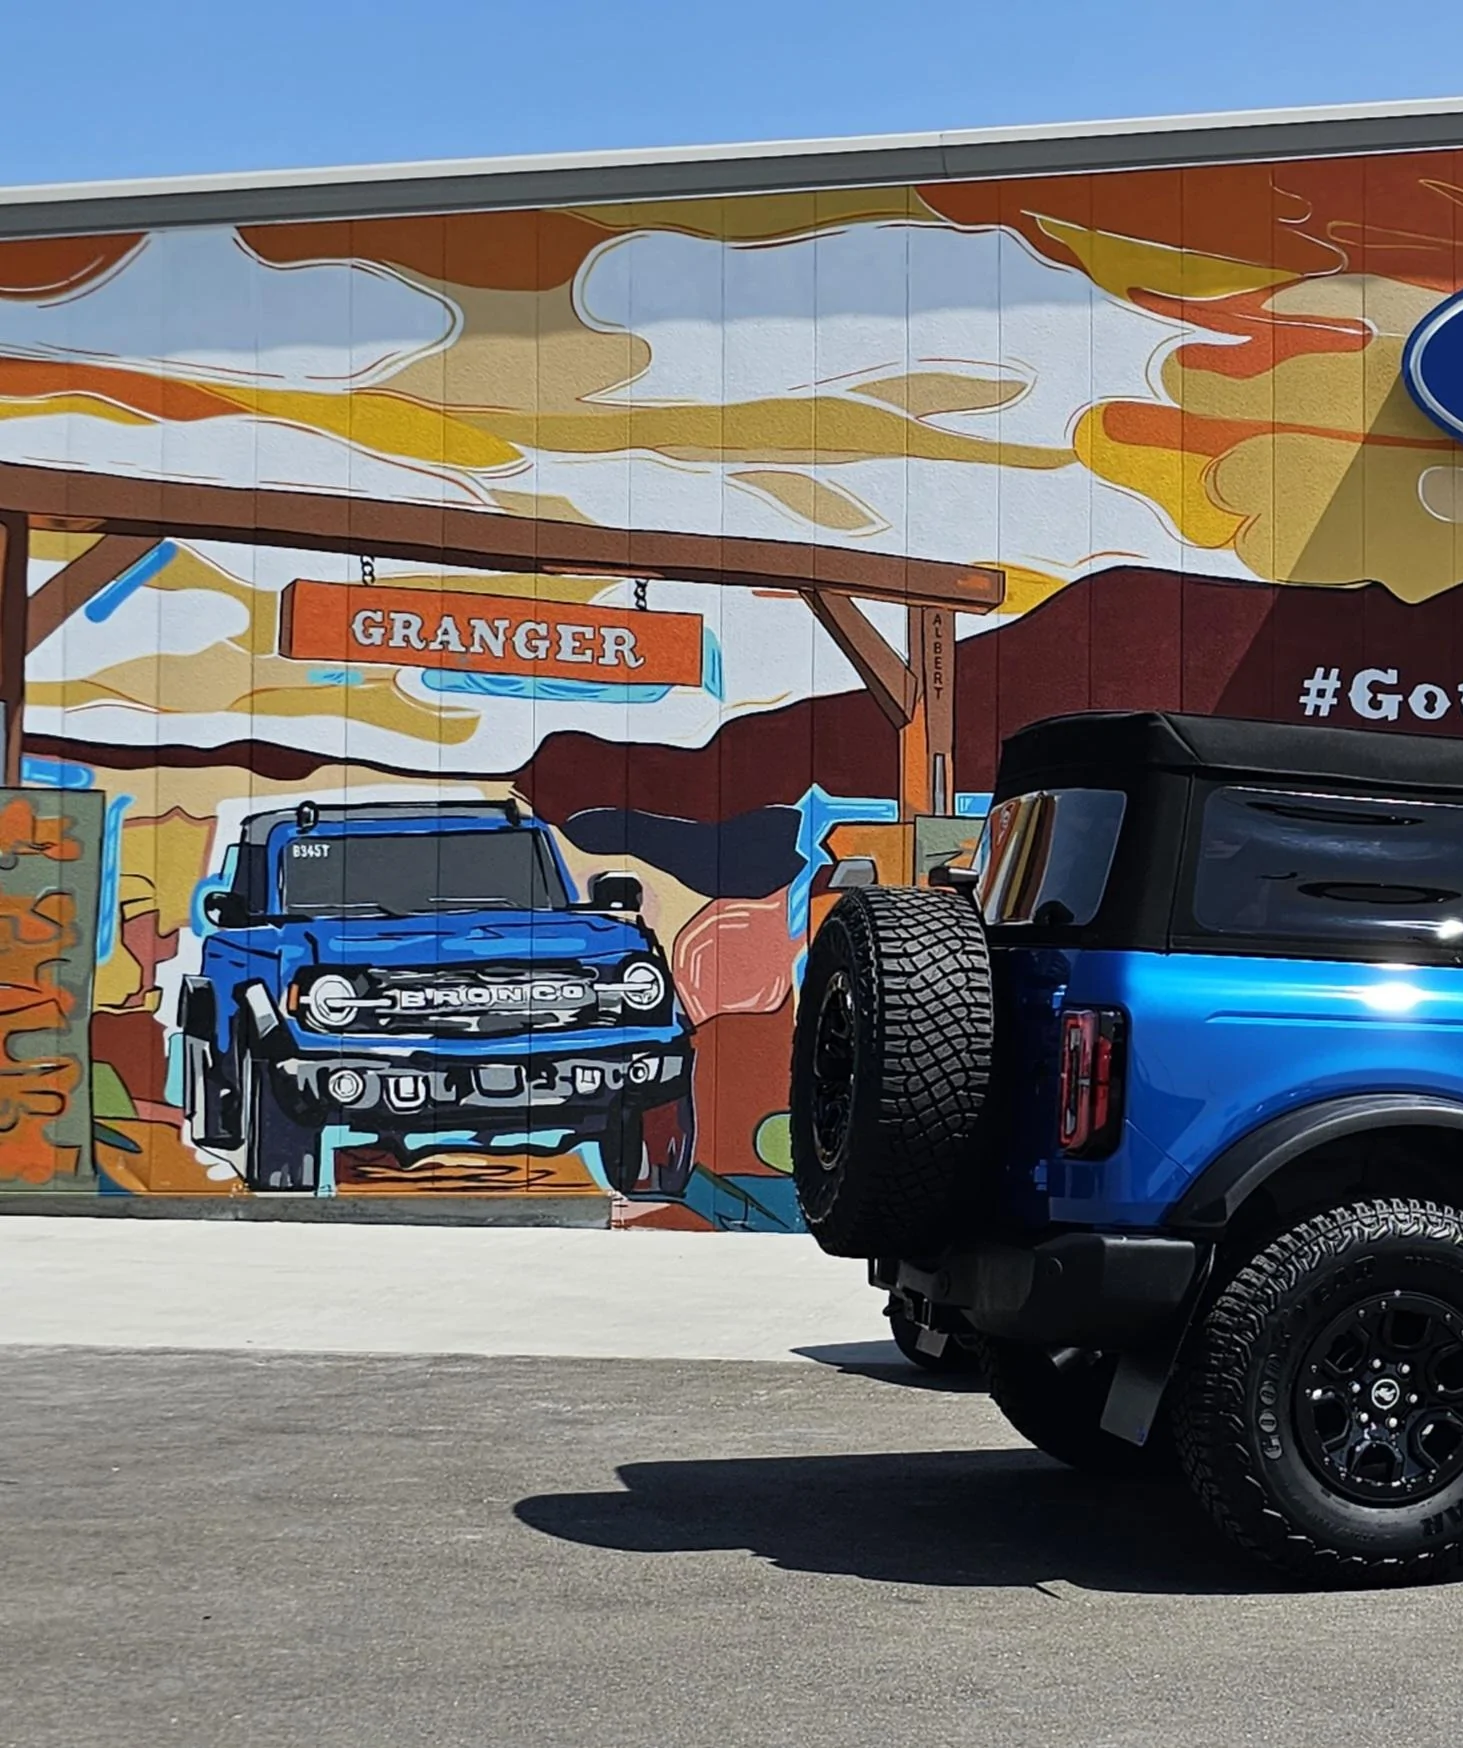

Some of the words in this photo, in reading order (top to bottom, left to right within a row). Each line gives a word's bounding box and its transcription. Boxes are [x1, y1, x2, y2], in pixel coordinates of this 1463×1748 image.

[351, 609, 645, 669] GRANGER
[932, 613, 943, 700] ALBERT
[401, 984, 584, 1008] BRONCO
